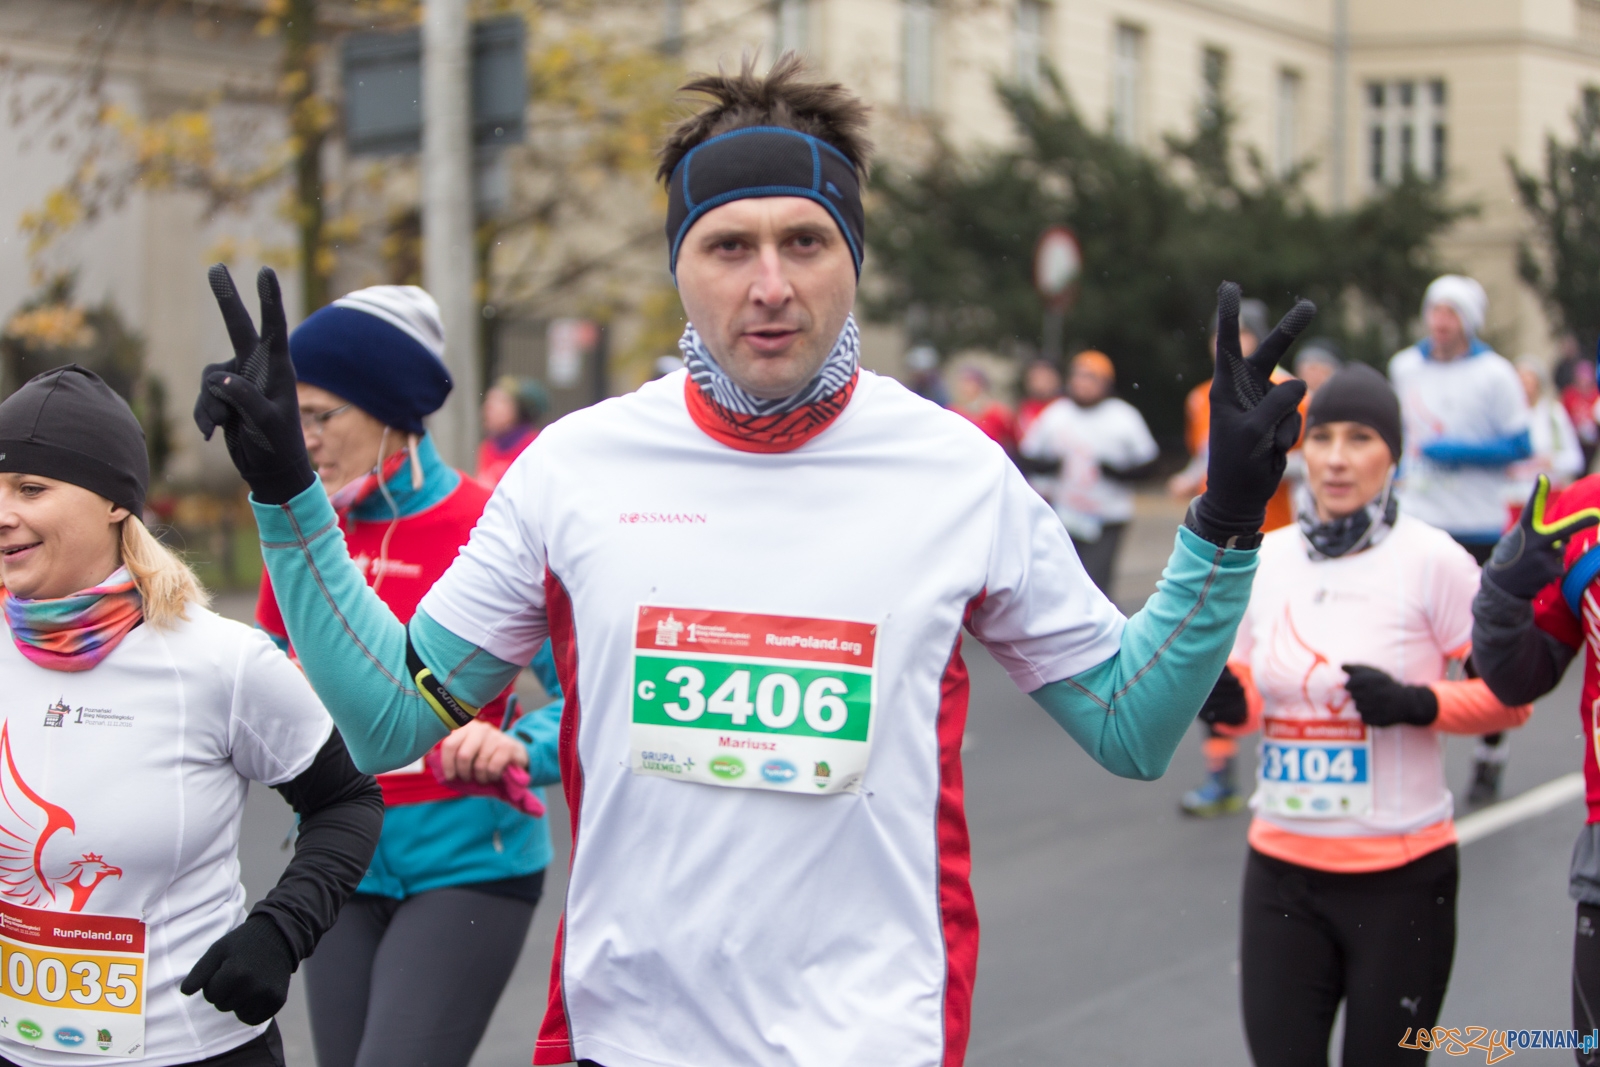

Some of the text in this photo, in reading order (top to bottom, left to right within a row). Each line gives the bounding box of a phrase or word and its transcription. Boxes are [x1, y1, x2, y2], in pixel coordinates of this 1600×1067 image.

[619, 512, 707, 524] ROSSMANN
[686, 622, 698, 643] 1
[765, 633, 862, 656] RunPoland.org
[663, 665, 849, 734] 3406
[74, 706, 84, 724] 1
[718, 736, 778, 751] Mariusz
[641, 750, 676, 762] GRUPA
[642, 760, 683, 774] LUXMED
[53, 927, 134, 944] RunPoland.org
[0, 944, 138, 1008] 0035
